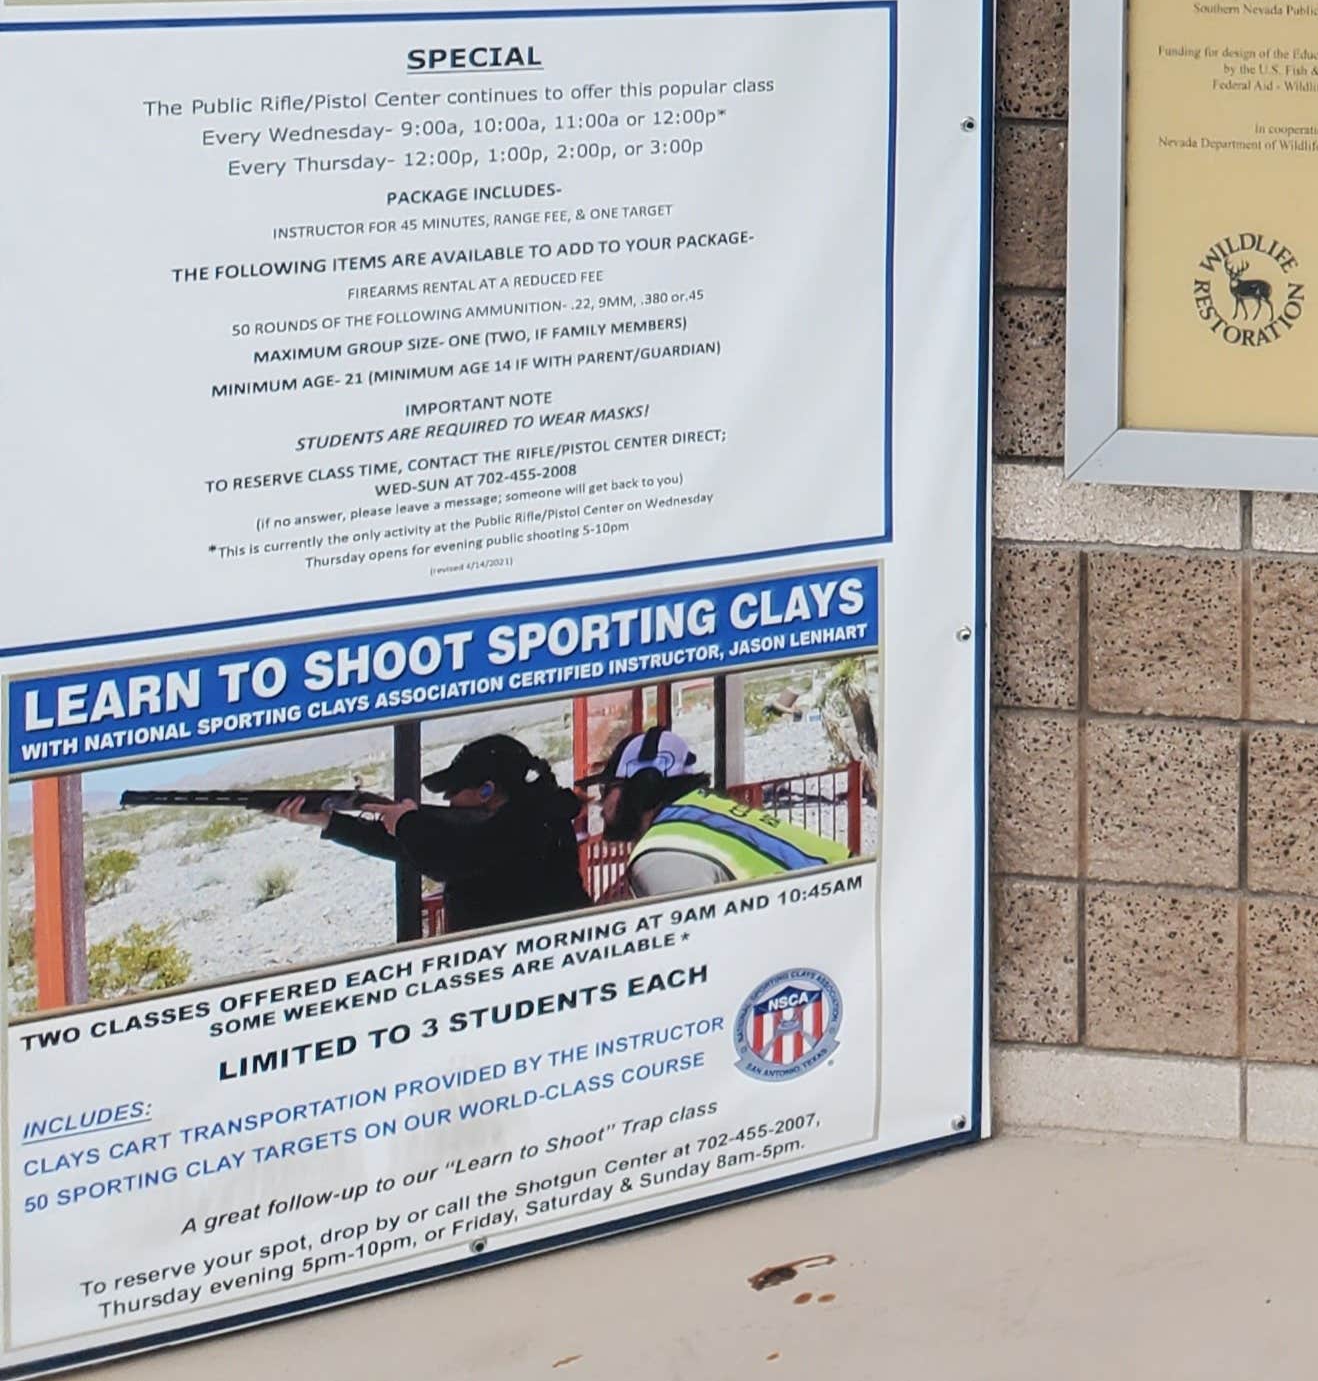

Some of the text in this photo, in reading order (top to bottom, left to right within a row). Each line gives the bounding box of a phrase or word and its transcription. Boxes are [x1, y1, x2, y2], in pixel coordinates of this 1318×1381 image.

[407, 46, 542, 70] SPECIAL
[387, 182, 562, 206] PACKAGE INCLUDES-
[273, 204, 674, 240] INSTRUCTOR FOR 45 MINUTES, RANGE FEE, & ONE TARGET
[1199, 232, 1298, 274] WILDLIFE
[1194, 278, 1305, 346] RESTORATION
[405, 391, 553, 417] IMPORTANT NOTE
[295, 404, 650, 452] STUDENTS ARE REQUIRED TO WEAR MASKS!
[24, 578, 866, 732] LEARN TO SHOOT SPORTING CLAYS
[767, 992, 810, 1011] NSCA
[219, 965, 709, 1081] LIMITED TO 3 STUDENTS EACH
[21, 1100, 153, 1141] INCLUDES:
